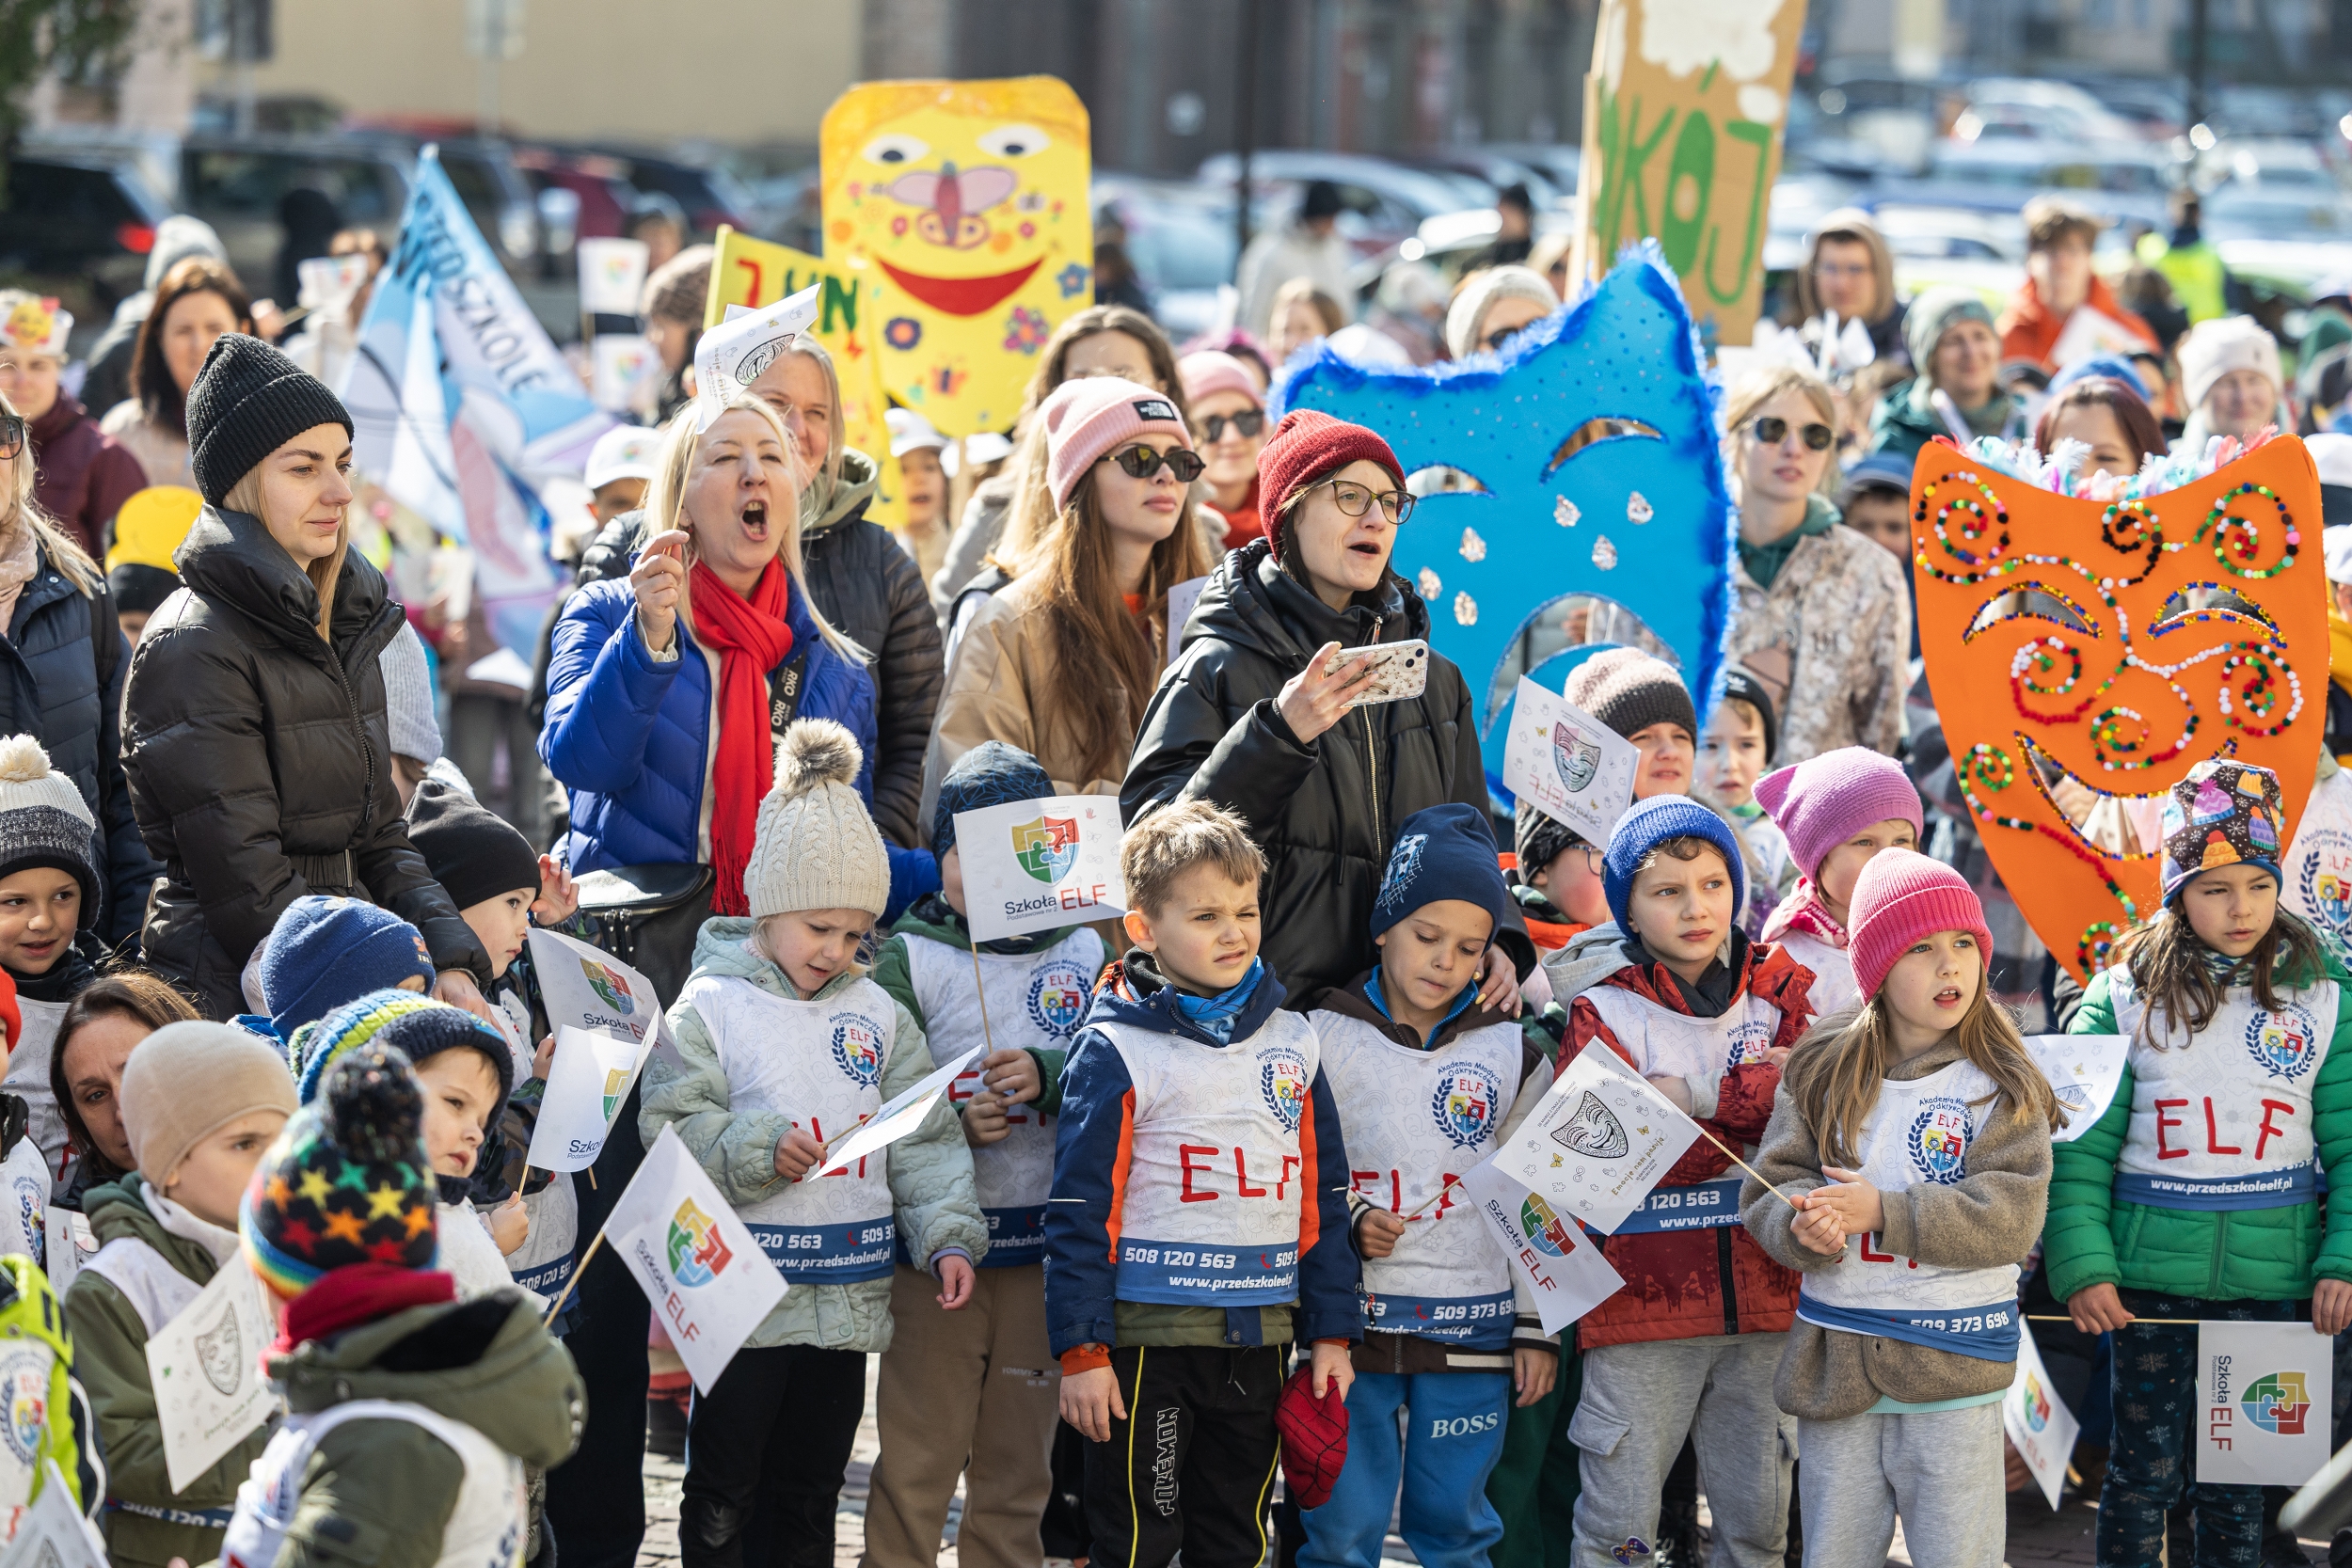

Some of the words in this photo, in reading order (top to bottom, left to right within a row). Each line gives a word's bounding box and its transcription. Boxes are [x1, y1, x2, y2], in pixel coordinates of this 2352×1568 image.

[784, 670, 798, 697] RKO
[771, 699, 786, 727] RKO
[1005, 895, 1057, 915] Szkoła
[1060, 884, 1106, 911] ELF
[1007, 910, 1045, 921] Podstawowa
[1049, 974, 1073, 986] ELF
[584, 1013, 629, 1031] Szkoła
[829, 1011, 858, 1024] Akademia
[2274, 1014, 2298, 1027] ELF
[2290, 1001, 2318, 1026] Młodych
[839, 1017, 879, 1035] Odkrywców
[850, 1028, 870, 1043] ELF
[1256, 1046, 1283, 1061] Akademia
[1745, 1040, 1767, 1054] ELF
[1265, 1053, 1304, 1067] Odkrywców
[1277, 1063, 1299, 1076] ELF
[1437, 1061, 1472, 1075] Akademia
[1475, 1062, 1502, 1086] Młodych
[1448, 1068, 1493, 1084] Odkrywców
[1460, 1078, 1483, 1093] ELF
[1919, 1095, 1953, 1106] Akademia
[1938, 1114, 1961, 1129] ELF
[2154, 1096, 2295, 1160] ELF
[1611, 1171, 1634, 1195] Emocje
[1634, 1157, 1646, 1169] nam
[2151, 1177, 2293, 1195] www.przedszkoleelf.pl
[1651, 1193, 1681, 1210] 120
[1686, 1190, 1720, 1207] 563
[1484, 1204, 1511, 1239] Podstawowa
[753, 1232, 784, 1248] 120
[787, 1234, 822, 1249] 563
[861, 1227, 883, 1244] 509
[1487, 1198, 1524, 1248] Szkoła
[1520, 1247, 1557, 1292] ELF
[1125, 1247, 1159, 1263] 508
[1163, 1250, 1195, 1267] 120
[1199, 1253, 1237, 1269] 563
[1275, 1252, 1293, 1268] 509
[542, 1268, 557, 1286] 120
[666, 1291, 701, 1344] ELF
[1433, 1306, 1467, 1320] 509
[1470, 1303, 1496, 1318] 373
[1950, 1315, 1982, 1333] 373
[1986, 1311, 2009, 1330] 698
[2218, 1355, 2231, 1403] Szkoła
[1430, 1412, 1498, 1438] BOSS
[2210, 1408, 2232, 1451] ELF
